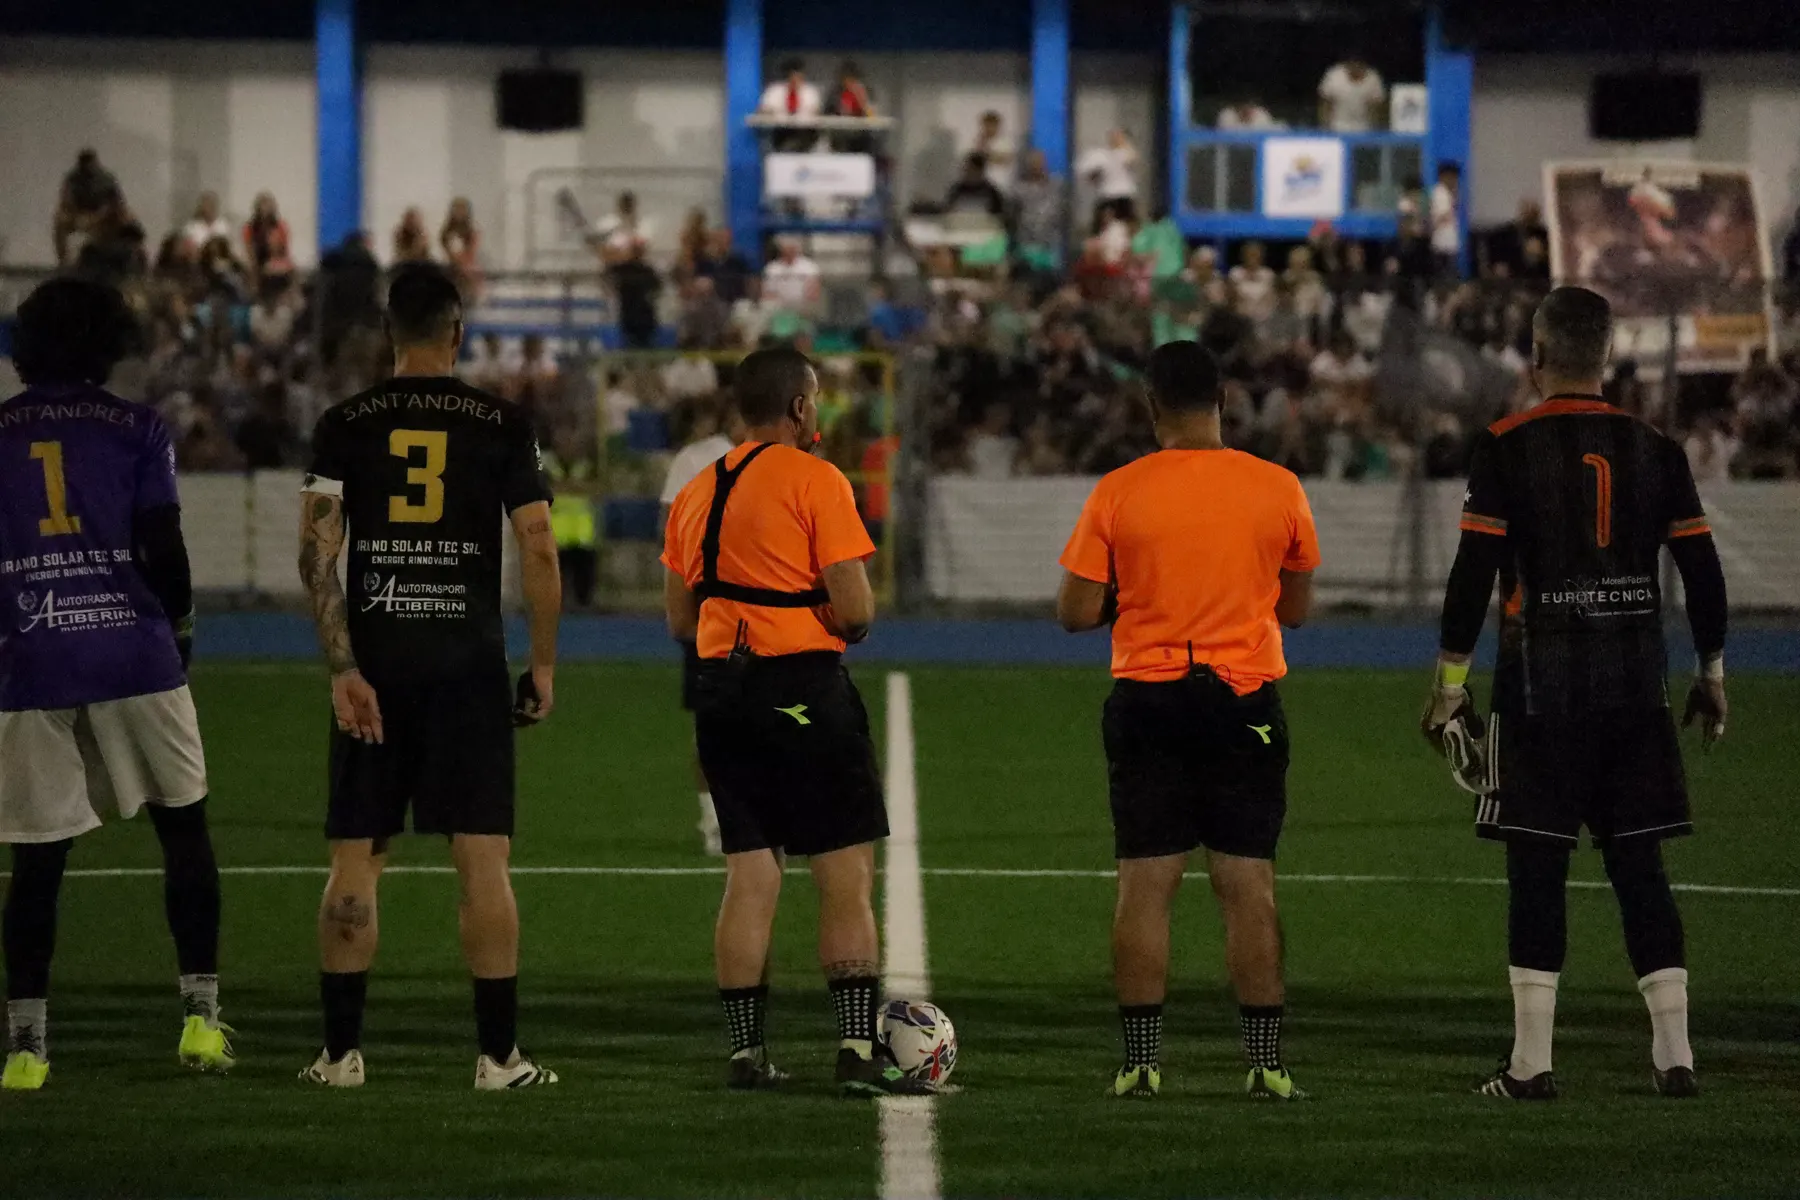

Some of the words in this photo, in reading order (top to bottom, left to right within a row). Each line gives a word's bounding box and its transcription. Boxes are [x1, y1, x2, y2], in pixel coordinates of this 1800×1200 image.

[344, 393, 502, 425] SANT'ANDREA
[388, 428, 448, 524] 3
[29, 441, 81, 537] 1
[1582, 453, 1611, 548] 1
[392, 540, 432, 553] SOLAR
[438, 541, 458, 554] TEC
[462, 542, 481, 555] SRL
[43, 551, 85, 567] SOLAR
[88, 550, 108, 563] TEC
[112, 549, 133, 562] SRL
[371, 556, 405, 565] ENERGIE
[408, 556, 458, 566] RINNOVABILI
[25, 569, 61, 582] ENERGIE
[396, 583, 466, 595] AUTOTRASPORTI
[1541, 588, 1653, 604] EUROTECNICA
[61, 623, 98, 633] monte
[103, 620, 137, 629] urano
